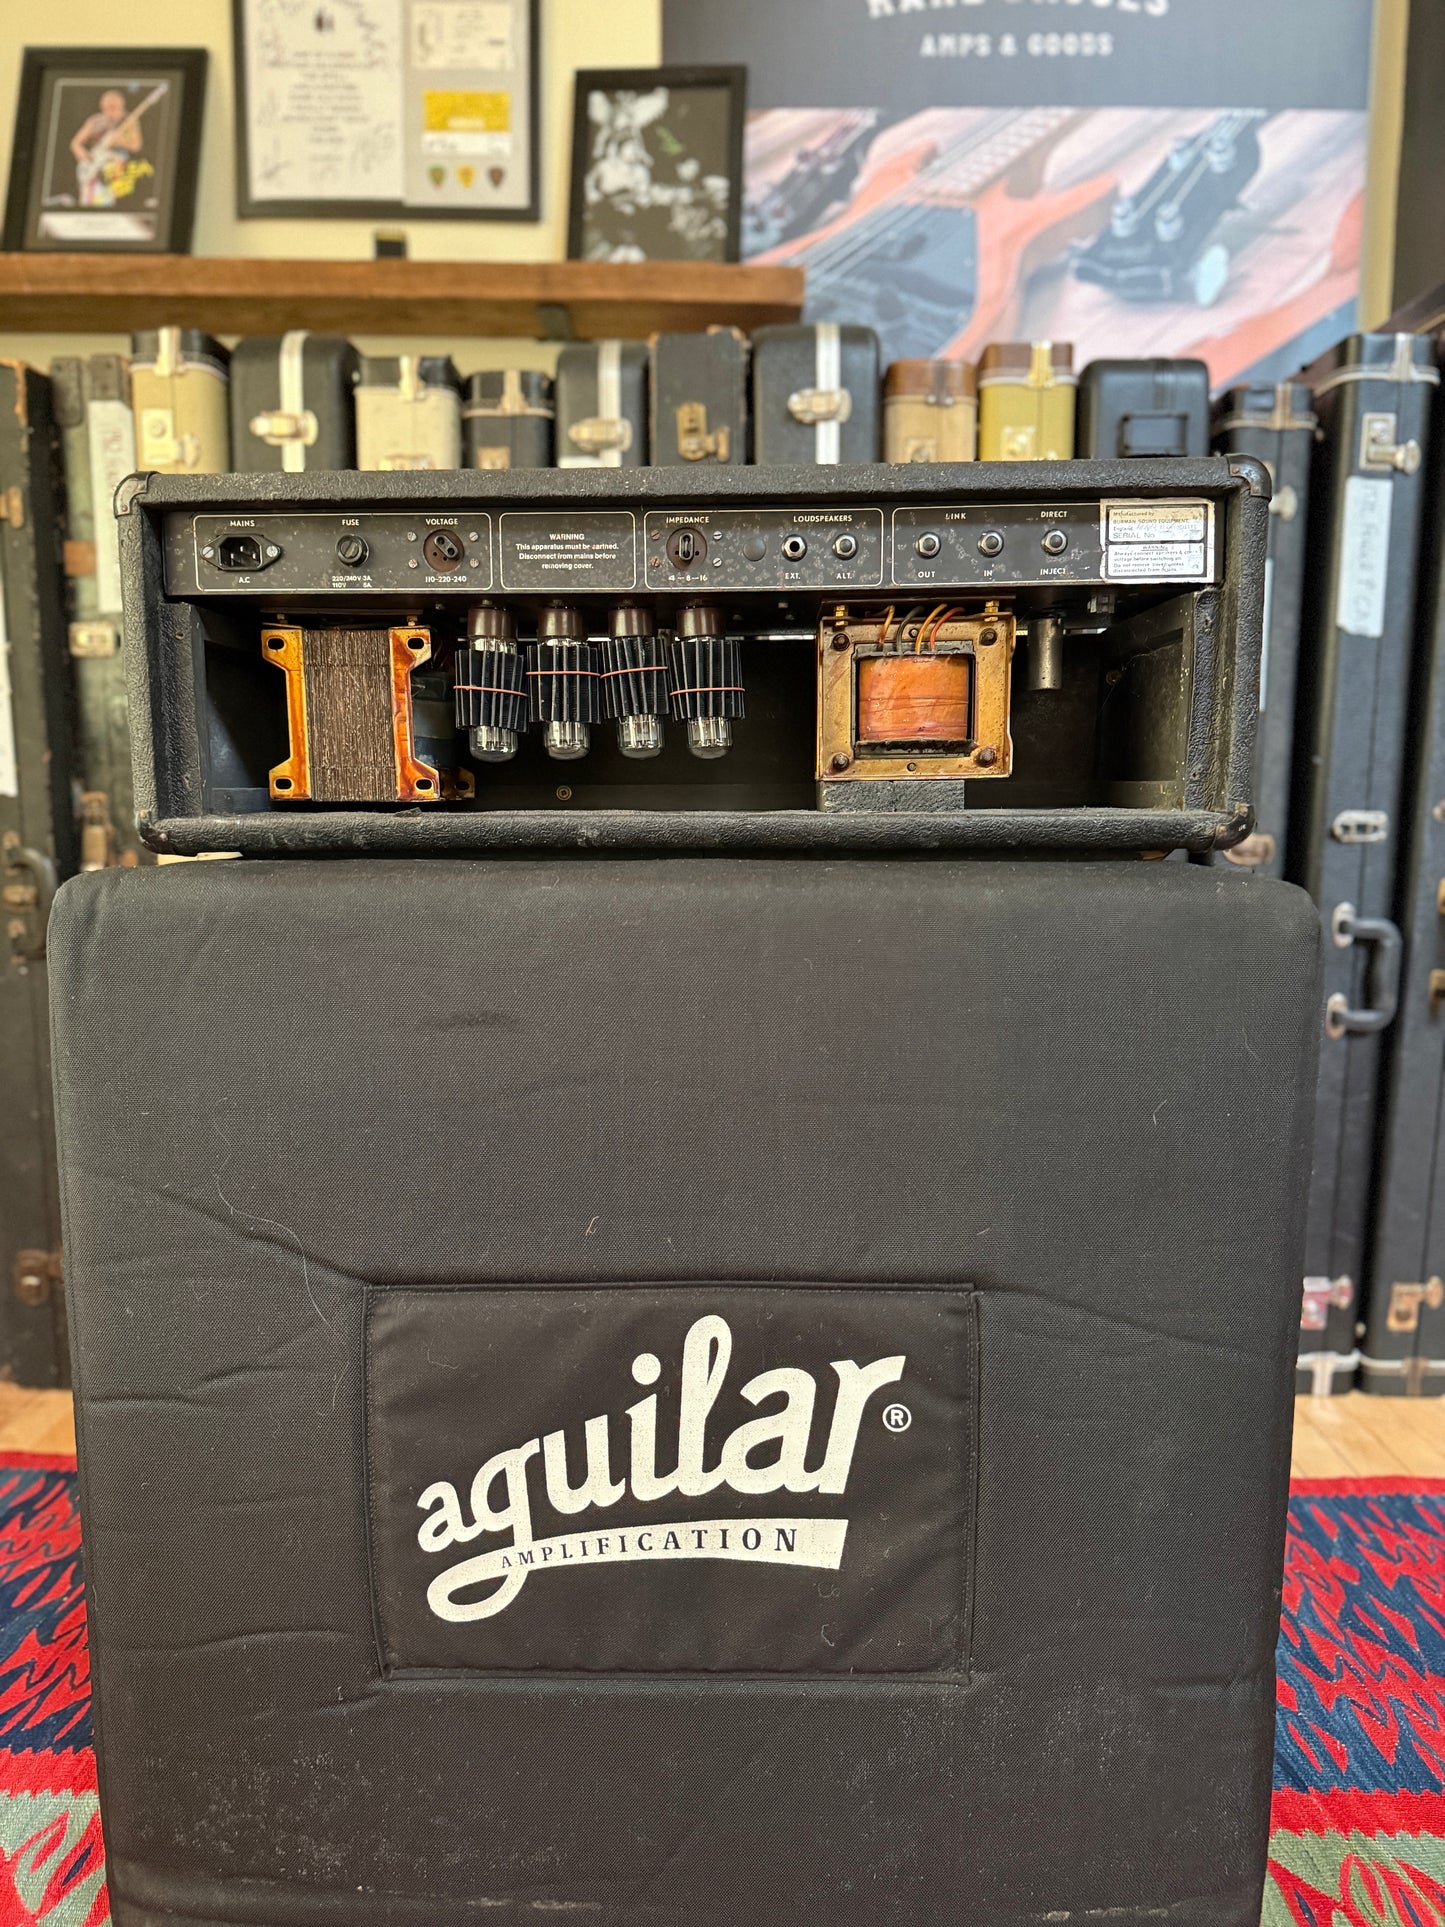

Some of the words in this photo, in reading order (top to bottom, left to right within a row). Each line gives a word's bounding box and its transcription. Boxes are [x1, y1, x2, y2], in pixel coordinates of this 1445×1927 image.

[919, 33, 991, 58] AMPS
[1027, 32, 1113, 57] GOODS
[1040, 510, 1068, 518] DIRECT
[665, 516, 710, 524] IMPEDANCE
[793, 514, 853, 523] LOUDSPEAKERS
[549, 533, 585, 541] WARNING
[531, 543, 564, 551] apparatus
[595, 552, 617, 560] before
[541, 562, 573, 570] removing
[917, 570, 936, 578] OUT
[983, 569, 993, 577] IN
[1040, 567, 1067, 575] INJECT
[425, 575, 467, 583] 110-220-240
[784, 572, 801, 580] EXT.
[836, 572, 853, 580] ALT.
[416, 1314, 907, 1623] aguilar
[500, 1527, 798, 1569] AMPLIFICATION
